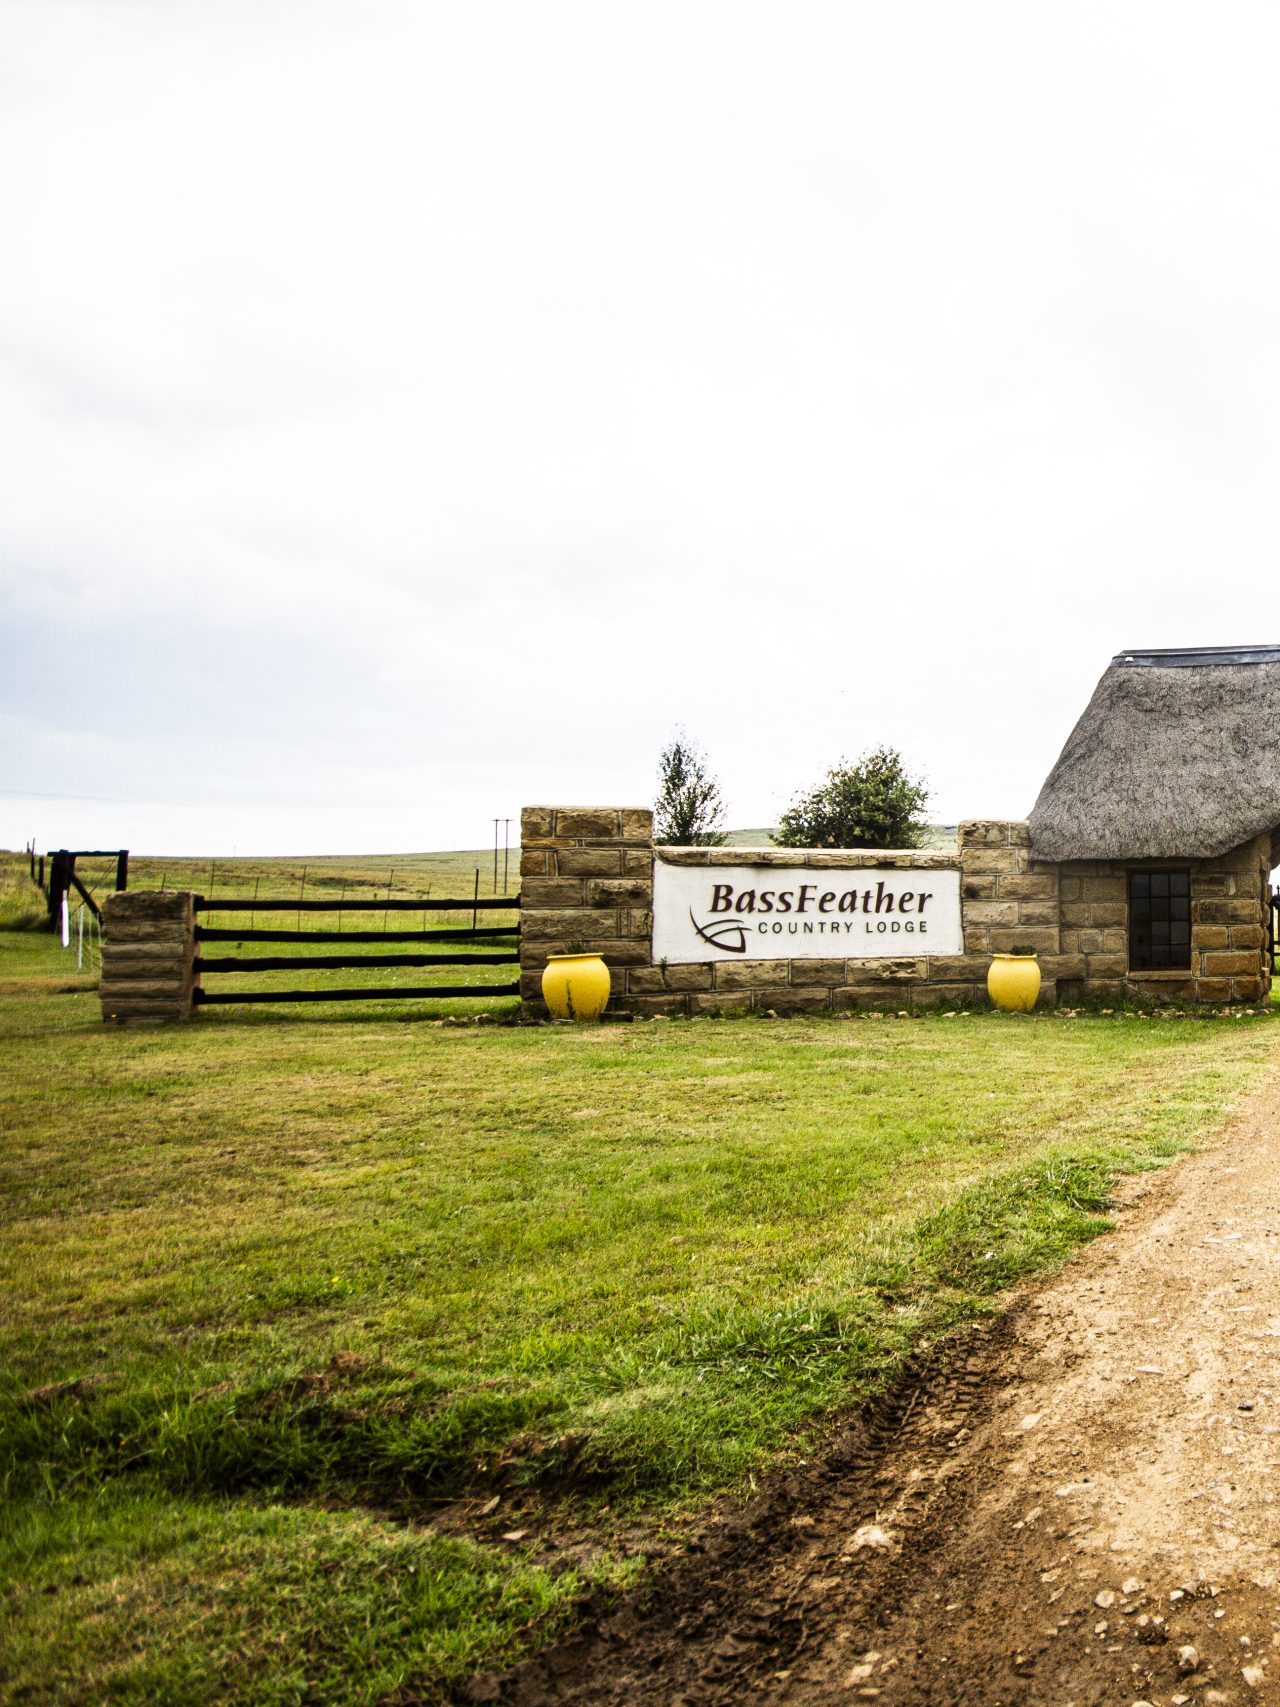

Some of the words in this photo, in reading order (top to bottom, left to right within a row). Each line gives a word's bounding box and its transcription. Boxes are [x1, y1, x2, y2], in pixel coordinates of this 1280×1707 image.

[708, 881, 933, 914] BassFeather
[758, 921, 853, 934] COUNTRY
[865, 920, 928, 934] LODGE
